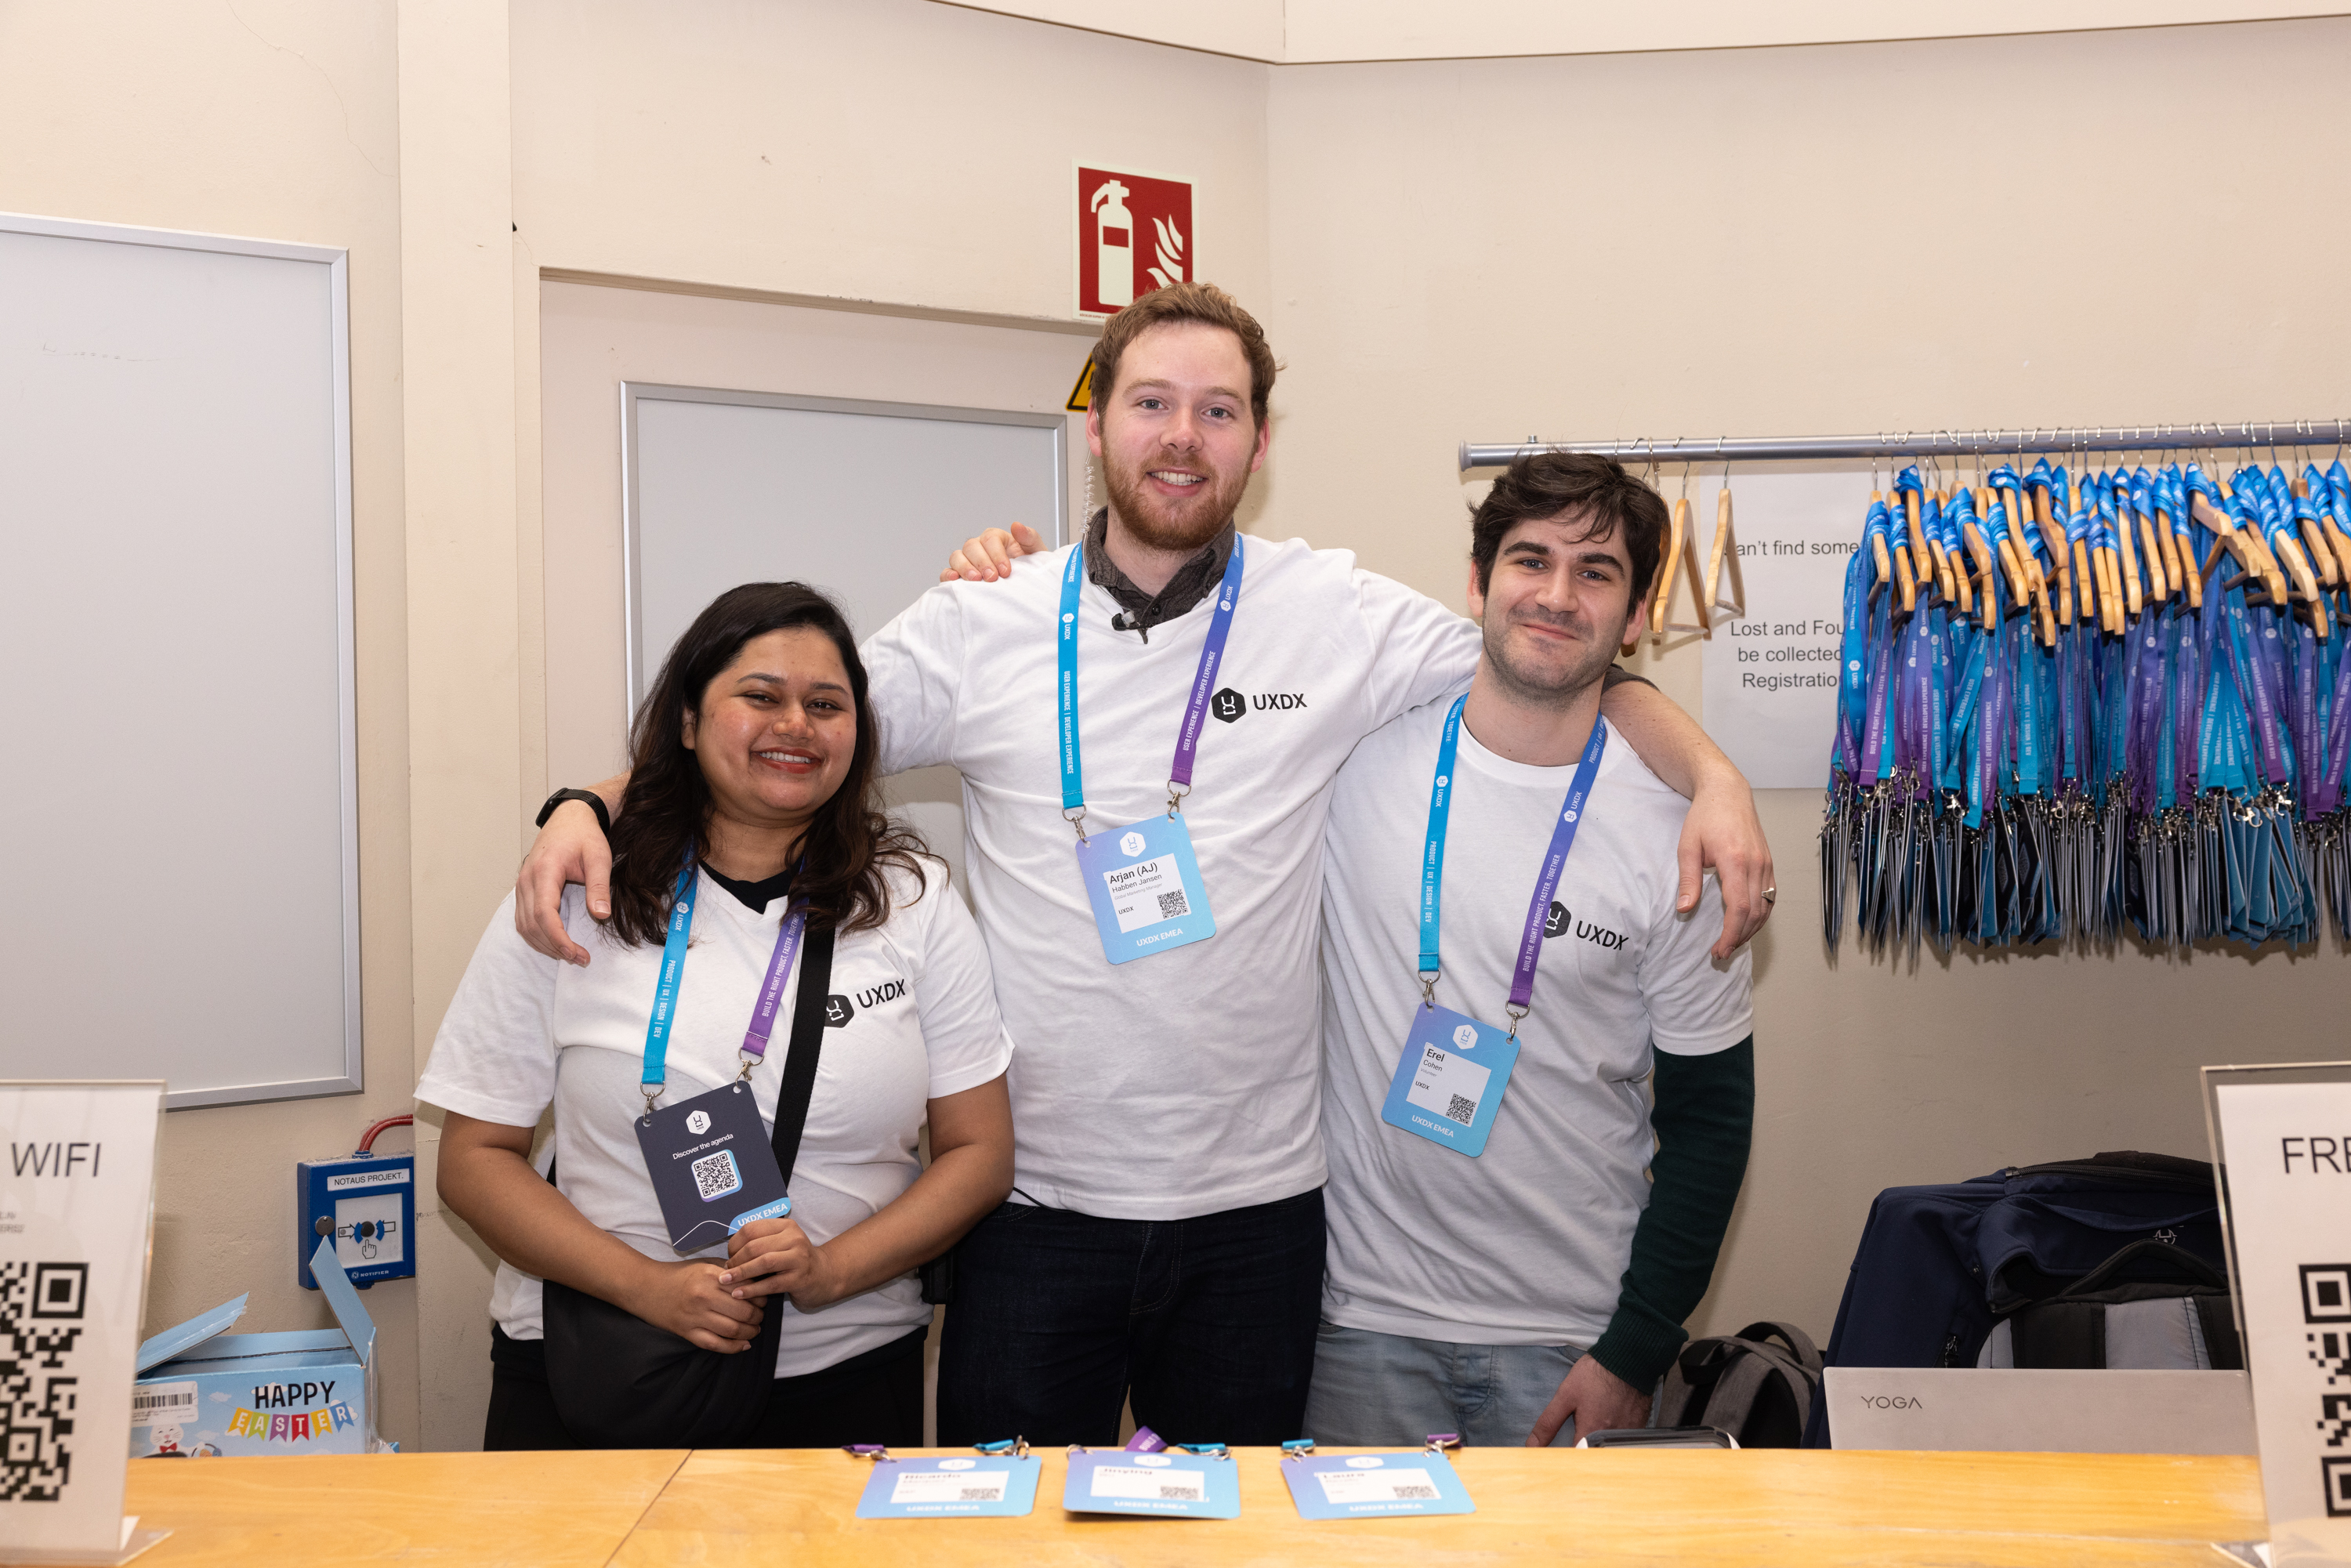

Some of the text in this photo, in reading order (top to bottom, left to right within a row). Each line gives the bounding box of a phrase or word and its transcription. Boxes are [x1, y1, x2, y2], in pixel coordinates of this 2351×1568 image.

[1724, 539, 1860, 556] an't find some
[1225, 585, 1233, 600] UXDX
[1730, 621, 1768, 636] Lost
[1773, 620, 1806, 636] and
[1737, 646, 1759, 662] be
[1742, 672, 1838, 691] Registratio
[1185, 710, 1200, 741] EXPERIENCE
[1196, 678, 1208, 706] DEVELOPER
[1202, 650, 1216, 679] EXPERIENCE
[1252, 693, 1308, 711] UXDX
[1872, 715, 1881, 730] RIGHT
[1588, 743, 1600, 764] PRODUCT
[1869, 739, 1878, 755] BUILD
[1066, 744, 1074, 775] EXPERIENCE
[1435, 788, 1444, 808] UXDX
[1570, 791, 1583, 810] UXDX
[1429, 840, 1437, 866] PRODUCT
[1110, 862, 1158, 884] Arjan (AJ)
[1426, 871, 1434, 879] UX
[1112, 874, 1163, 893] Habben Jansen
[1126, 886, 1146, 897] Marketing
[1146, 882, 1163, 893] Manager
[1118, 906, 1135, 915] UXDX
[1523, 853, 1561, 972] BUILD THE RIGHT PRODUCT, FASTER, TOGETHER
[675, 914, 684, 932] UXDX
[1136, 928, 1184, 947] UXDX EMEA
[1576, 920, 1629, 951] UXDX
[762, 913, 800, 1017] BUILD THE RIGHT PRODUCT, FASTER, TOGETHER
[653, 959, 676, 1038] PRODUCT UX DESIGN DEV
[856, 979, 906, 1009] UXDX
[1426, 1048, 1445, 1063] Erel
[1420, 1067, 1437, 1077] Volunteer
[1423, 1059, 1443, 1072] Cohen
[1415, 1080, 1430, 1091] UXDX
[1411, 1114, 1454, 1138] UXDX EMEA
[672, 1133, 734, 1160] Discover the agenda
[11, 1141, 102, 1177] WIFI
[334, 1171, 404, 1186] NOTAUS PROJEKT.
[737, 1203, 788, 1227] UXDX EMEA
[255, 1380, 336, 1410] HAPPY
[1860, 1396, 1923, 1410] YOGA
[236, 1406, 348, 1432] EASTER
